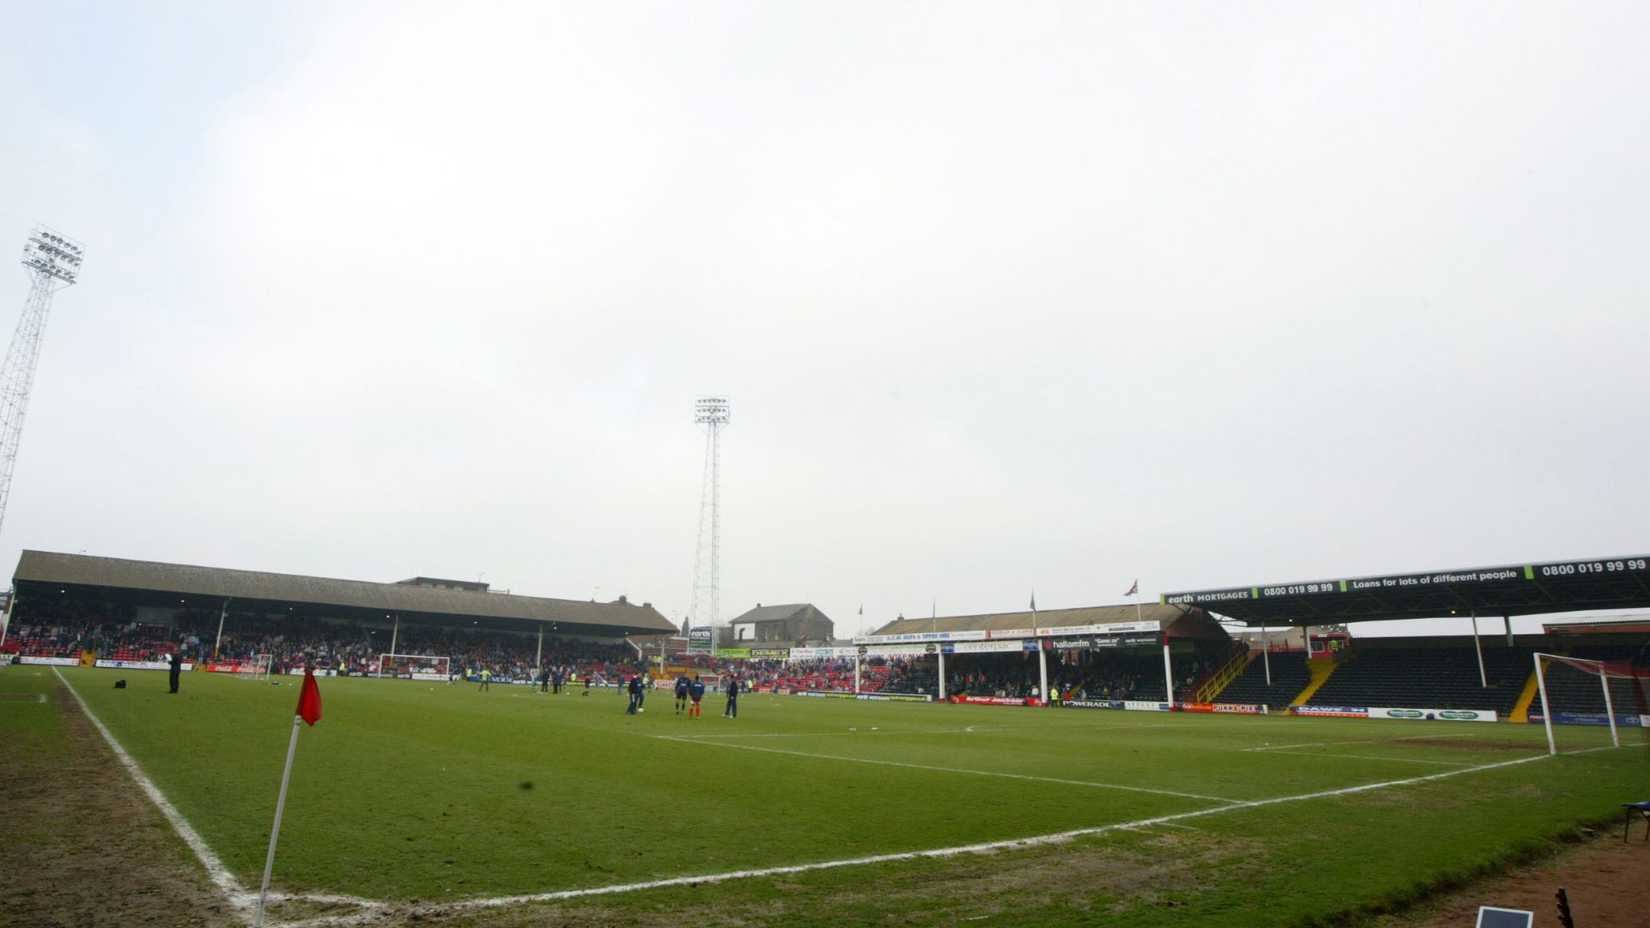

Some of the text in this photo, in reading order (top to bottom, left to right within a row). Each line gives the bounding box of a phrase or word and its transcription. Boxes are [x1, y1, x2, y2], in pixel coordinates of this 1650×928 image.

[1542, 559, 1646, 576] 0800 019 99 99
[1353, 570, 1517, 589] Loans for lots of different people
[1264, 583, 1333, 596] 0800 019 99 99
[1168, 591, 1249, 604] earth MORTGAGES
